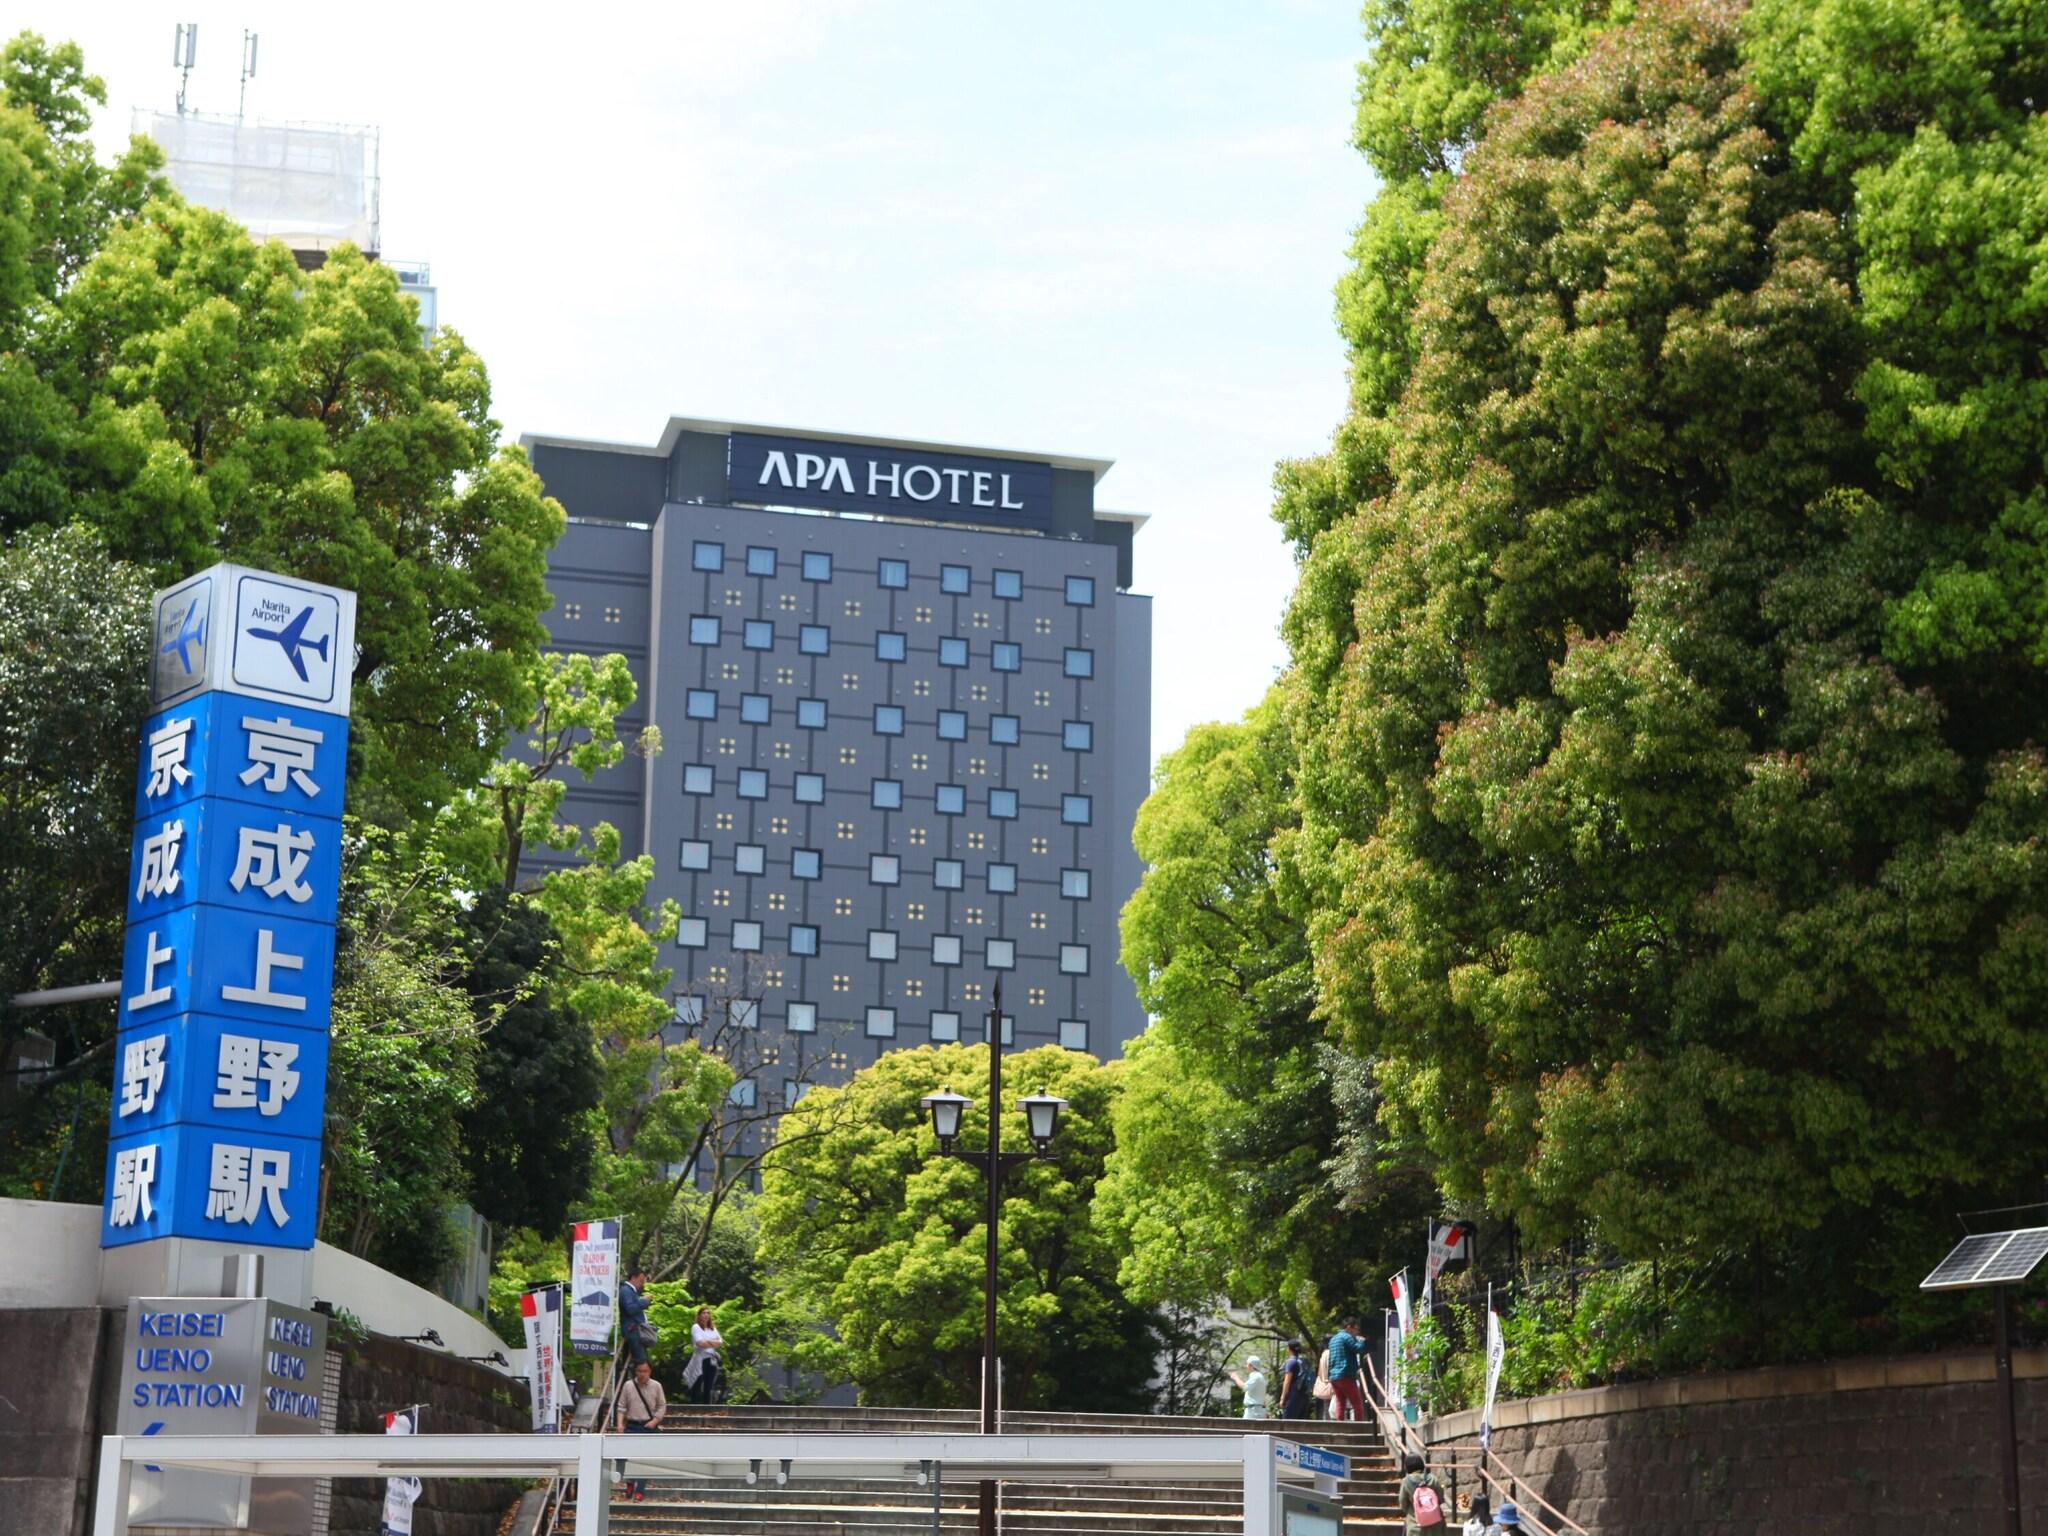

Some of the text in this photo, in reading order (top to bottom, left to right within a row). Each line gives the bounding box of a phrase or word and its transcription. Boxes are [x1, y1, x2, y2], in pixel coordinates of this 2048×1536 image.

[758, 450, 1024, 510] APA HOTEL
[252, 607, 285, 623] Airport
[262, 598, 290, 615] Narita
[109, 717, 193, 1227] 京成上野駅
[205, 716, 324, 1228] 京成上野駅
[139, 1313, 225, 1337] KEISEI
[271, 1316, 312, 1347] KEISEI
[136, 1349, 211, 1372] UENO
[268, 1351, 306, 1381] UENO
[133, 1383, 244, 1407] STATION
[265, 1386, 319, 1419] STATION
